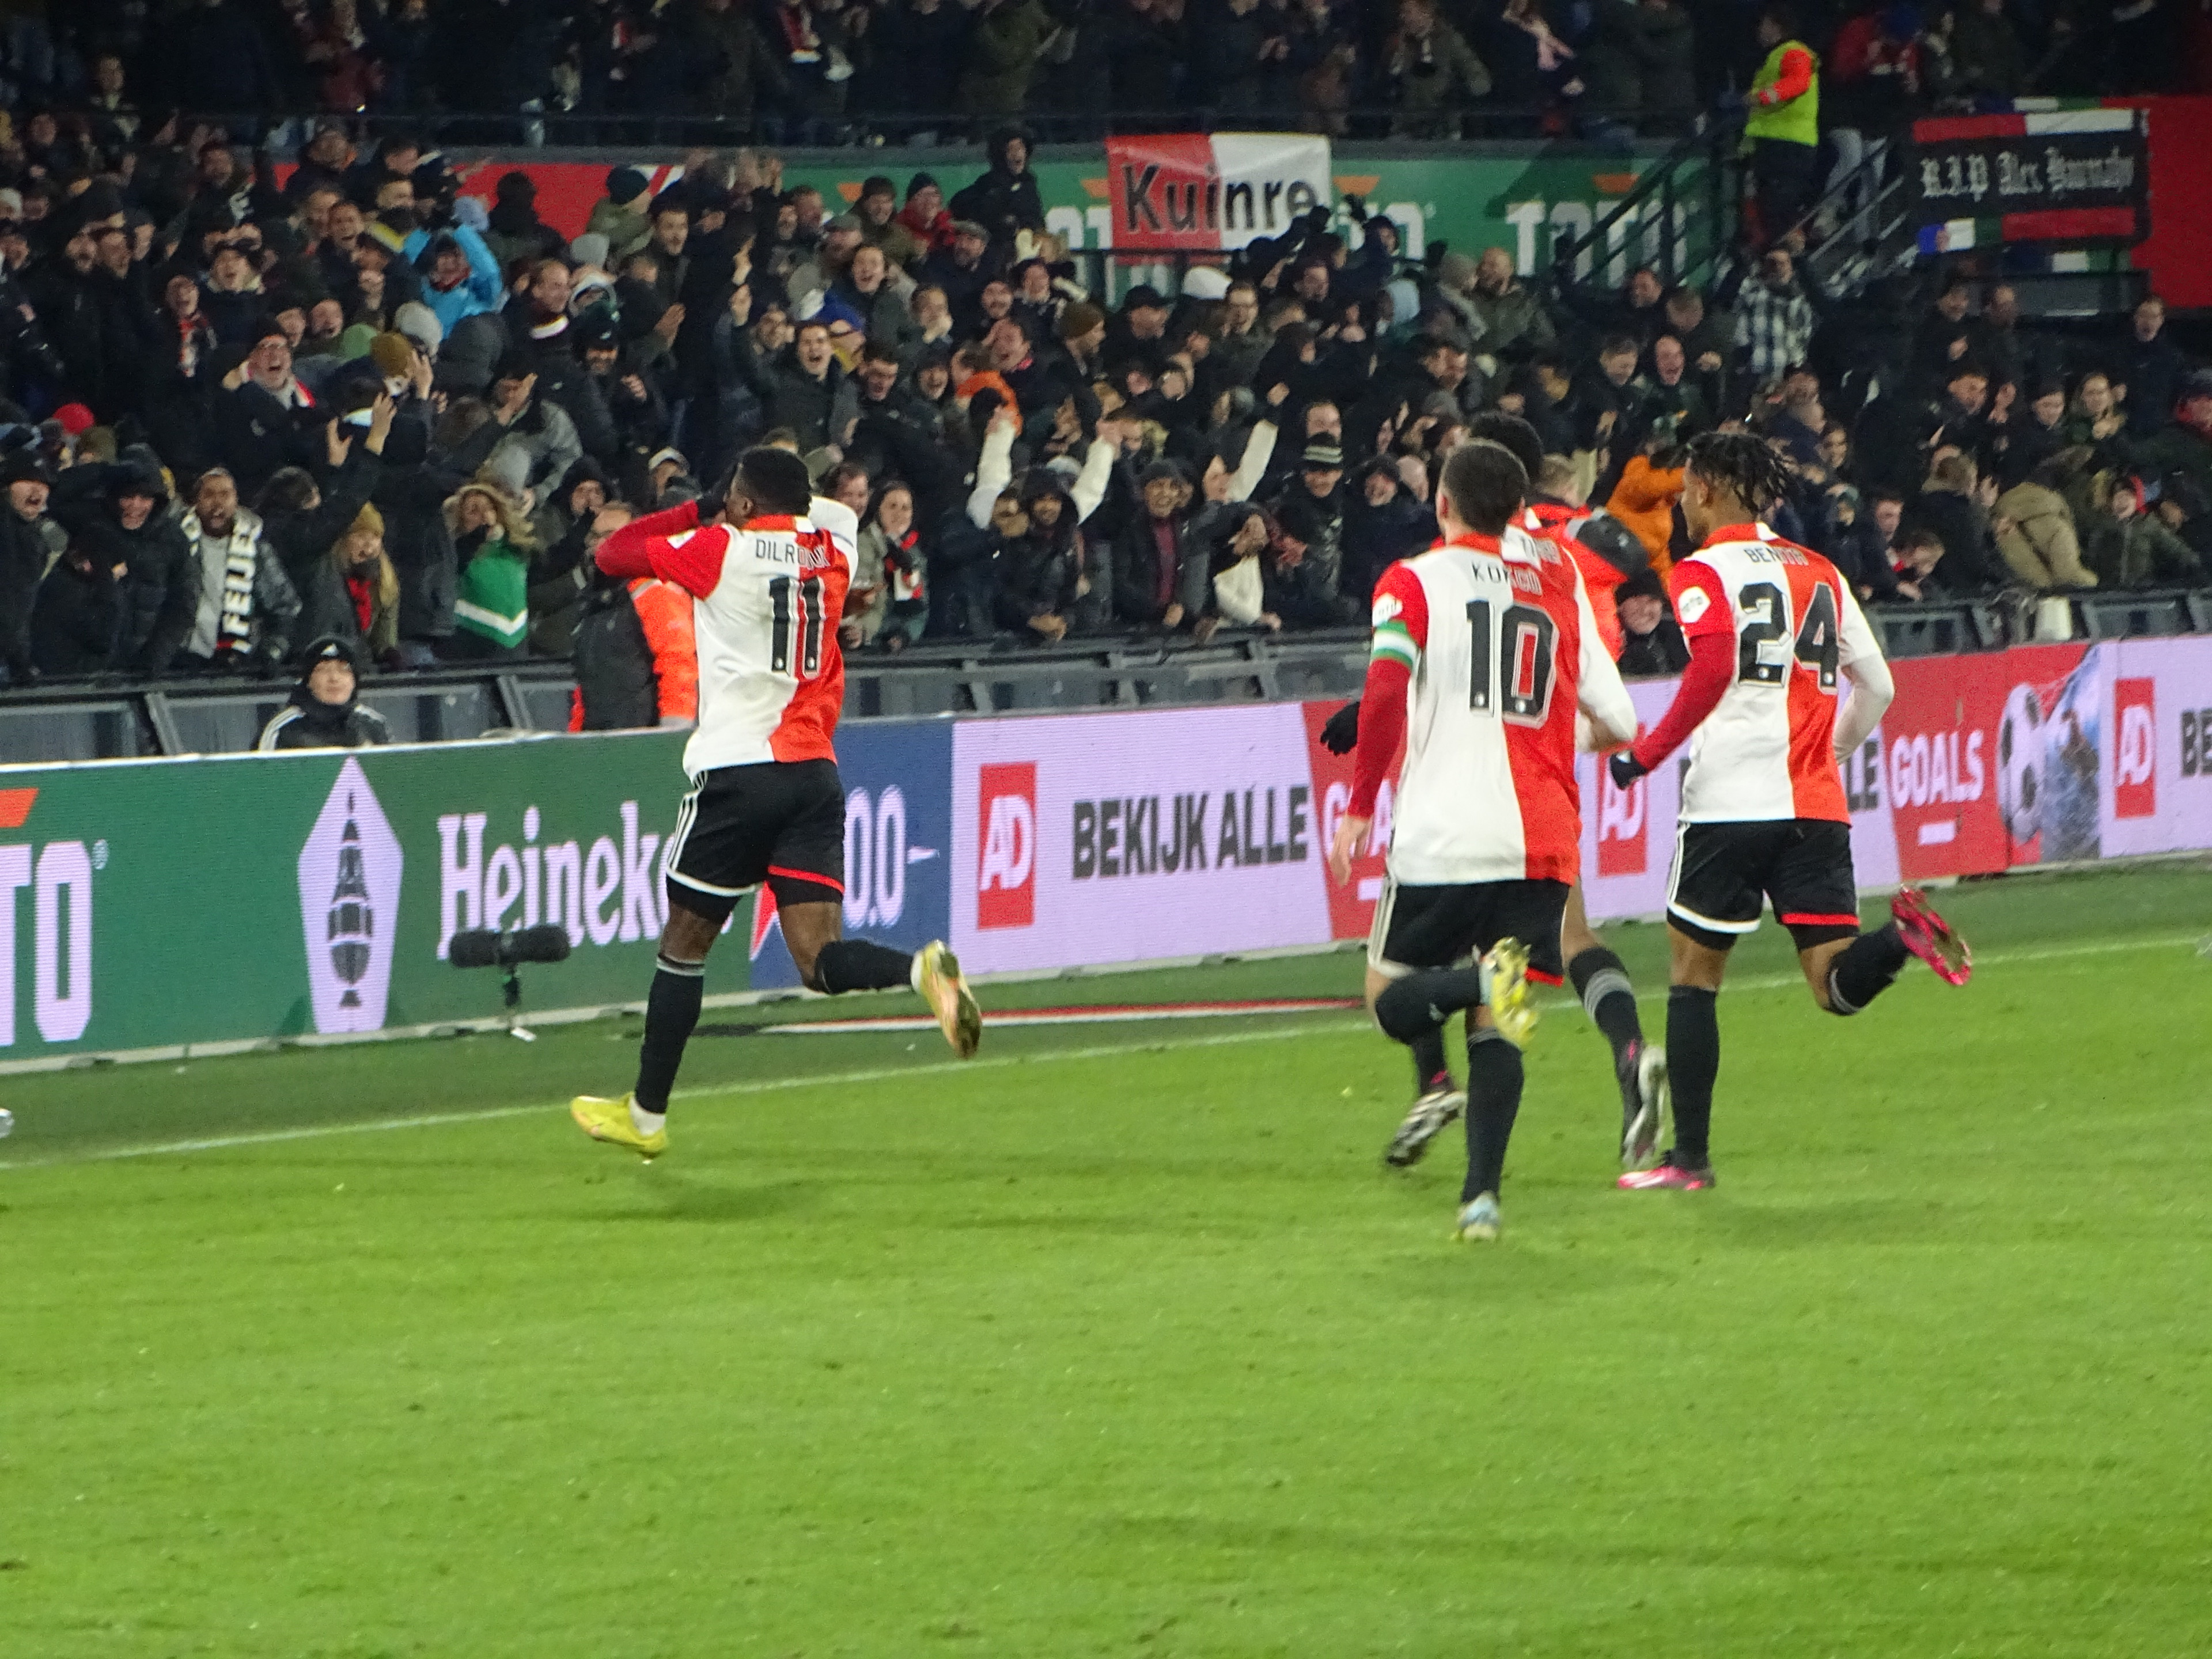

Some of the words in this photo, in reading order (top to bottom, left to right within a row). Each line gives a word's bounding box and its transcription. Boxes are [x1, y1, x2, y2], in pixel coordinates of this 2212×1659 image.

[1120, 163, 1320, 233] Kuinre
[768, 575, 826, 678] 11
[1465, 599, 1560, 729] 10
[1738, 581, 1840, 696] 24
[1891, 728, 1985, 809] GOALS
[2114, 704, 2154, 786] AD
[436, 800, 733, 960] Heinek
[980, 793, 1035, 892] AD
[1071, 791, 1209, 880] BEKIJK
[1217, 785, 1310, 869] ALLE
